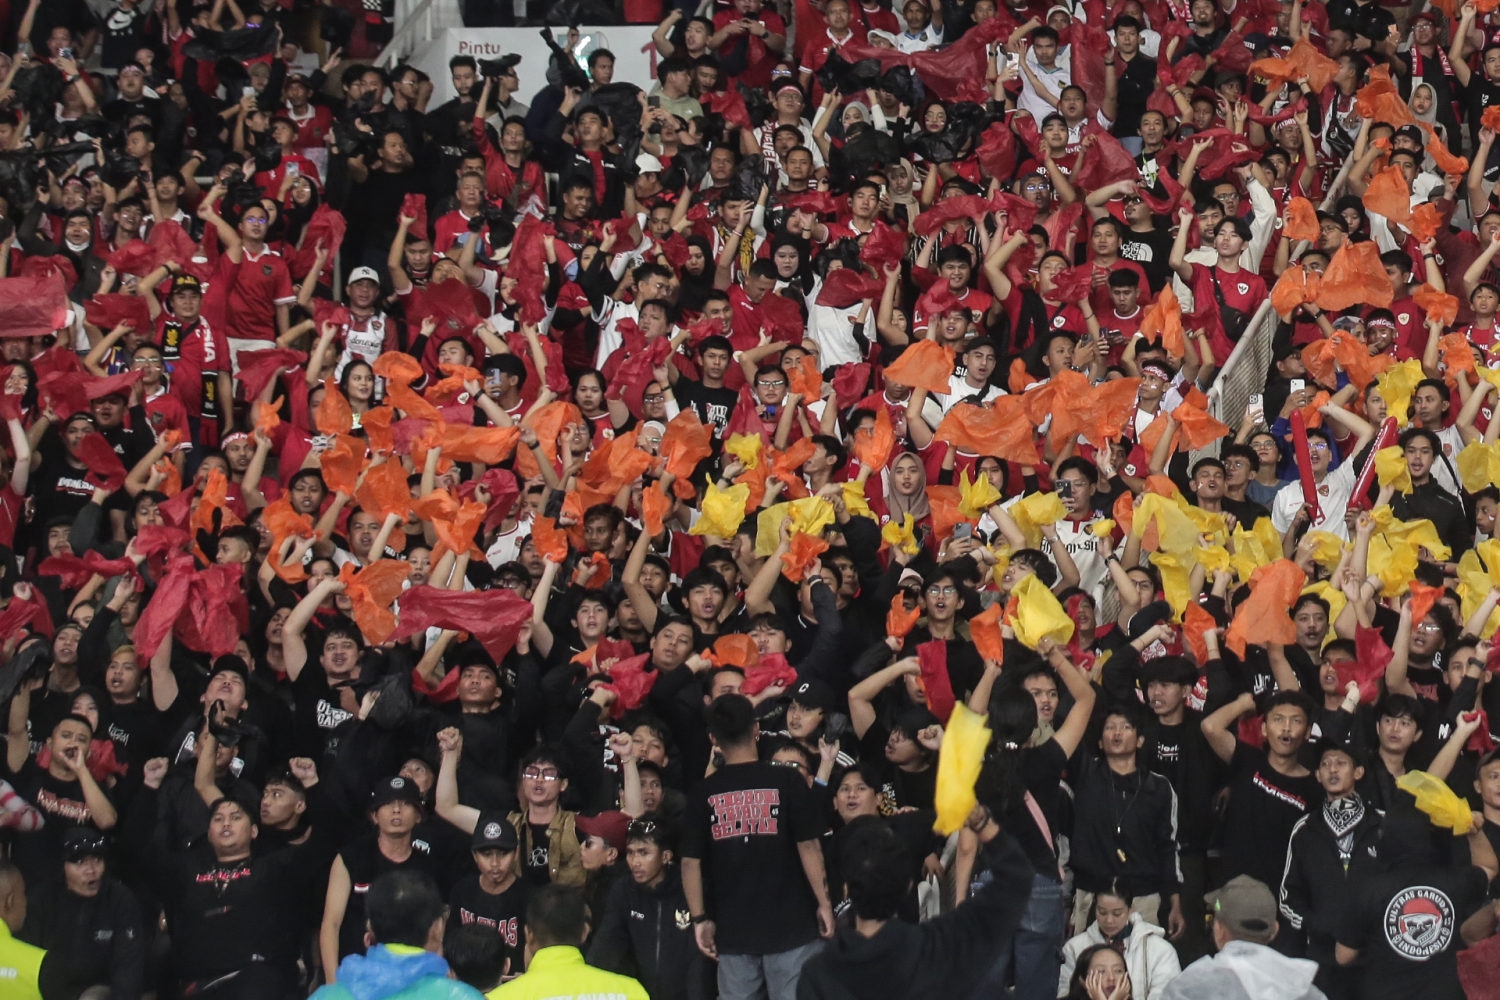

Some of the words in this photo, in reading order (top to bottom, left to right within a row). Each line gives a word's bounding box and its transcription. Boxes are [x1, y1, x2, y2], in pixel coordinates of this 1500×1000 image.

[459, 41, 500, 54] Pintu
[799, 683, 809, 692] C
[714, 804, 772, 825] TRIBUN
[712, 818, 778, 840] SELATAN
[1390, 892, 1416, 923] ULTRAS
[1417, 891, 1449, 915] GARUDA
[1398, 932, 1447, 956] INDONESIA
